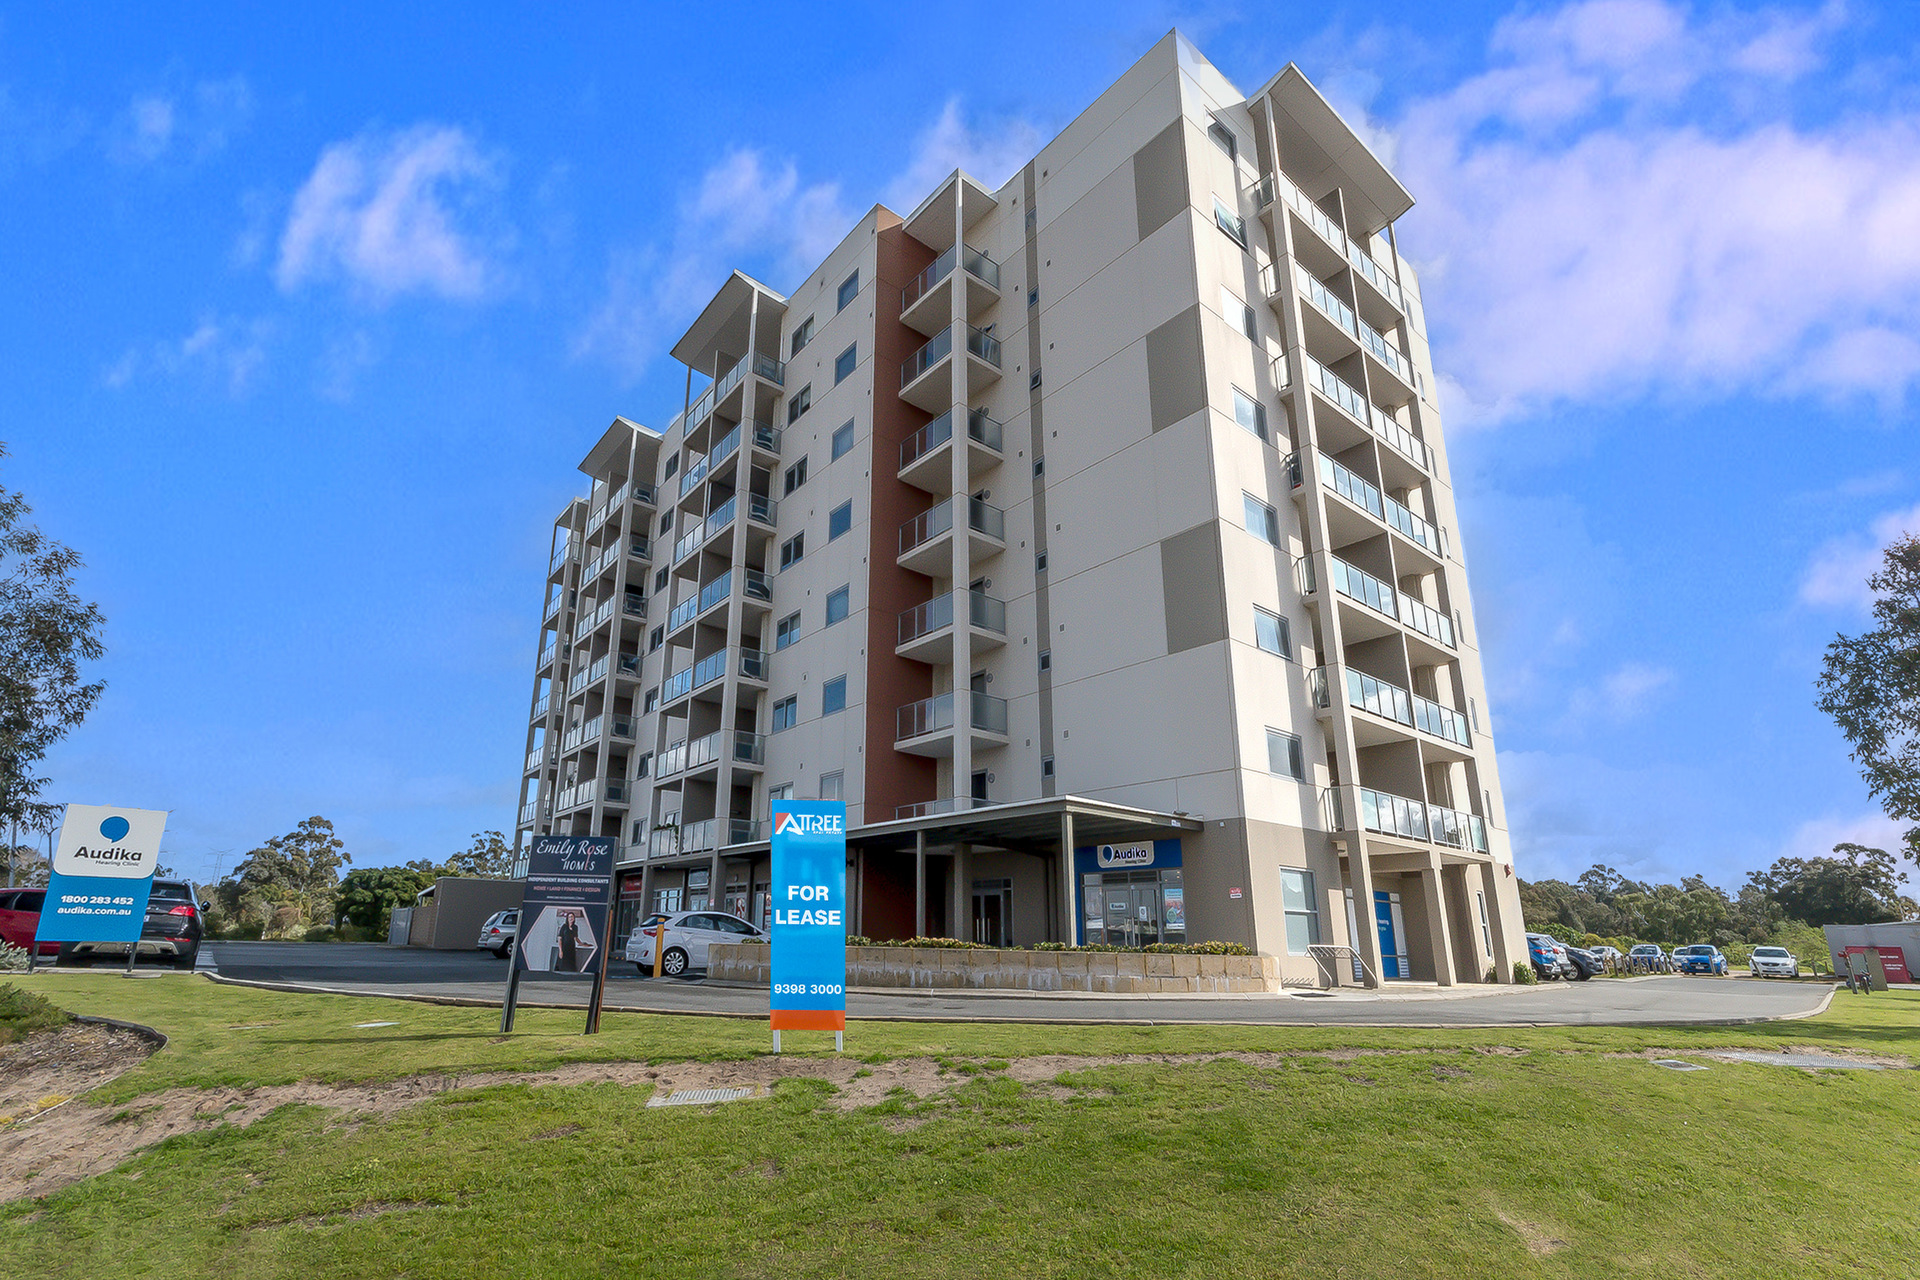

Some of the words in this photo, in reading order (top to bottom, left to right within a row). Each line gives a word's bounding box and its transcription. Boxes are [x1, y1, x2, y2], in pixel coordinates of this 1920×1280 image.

[73, 846, 142, 861] Audika
[536, 839, 575, 861] Emily
[577, 840, 608, 855] Rose
[1114, 846, 1147, 860] Audika
[61, 895, 88, 904] 1800
[89, 896, 111, 904] 283
[112, 897, 134, 905] 452
[788, 885, 829, 901] FOR
[57, 907, 132, 915] audika.com.au
[775, 909, 841, 925] LEASE
[774, 984, 806, 994] 9398
[810, 984, 842, 995] 3000
